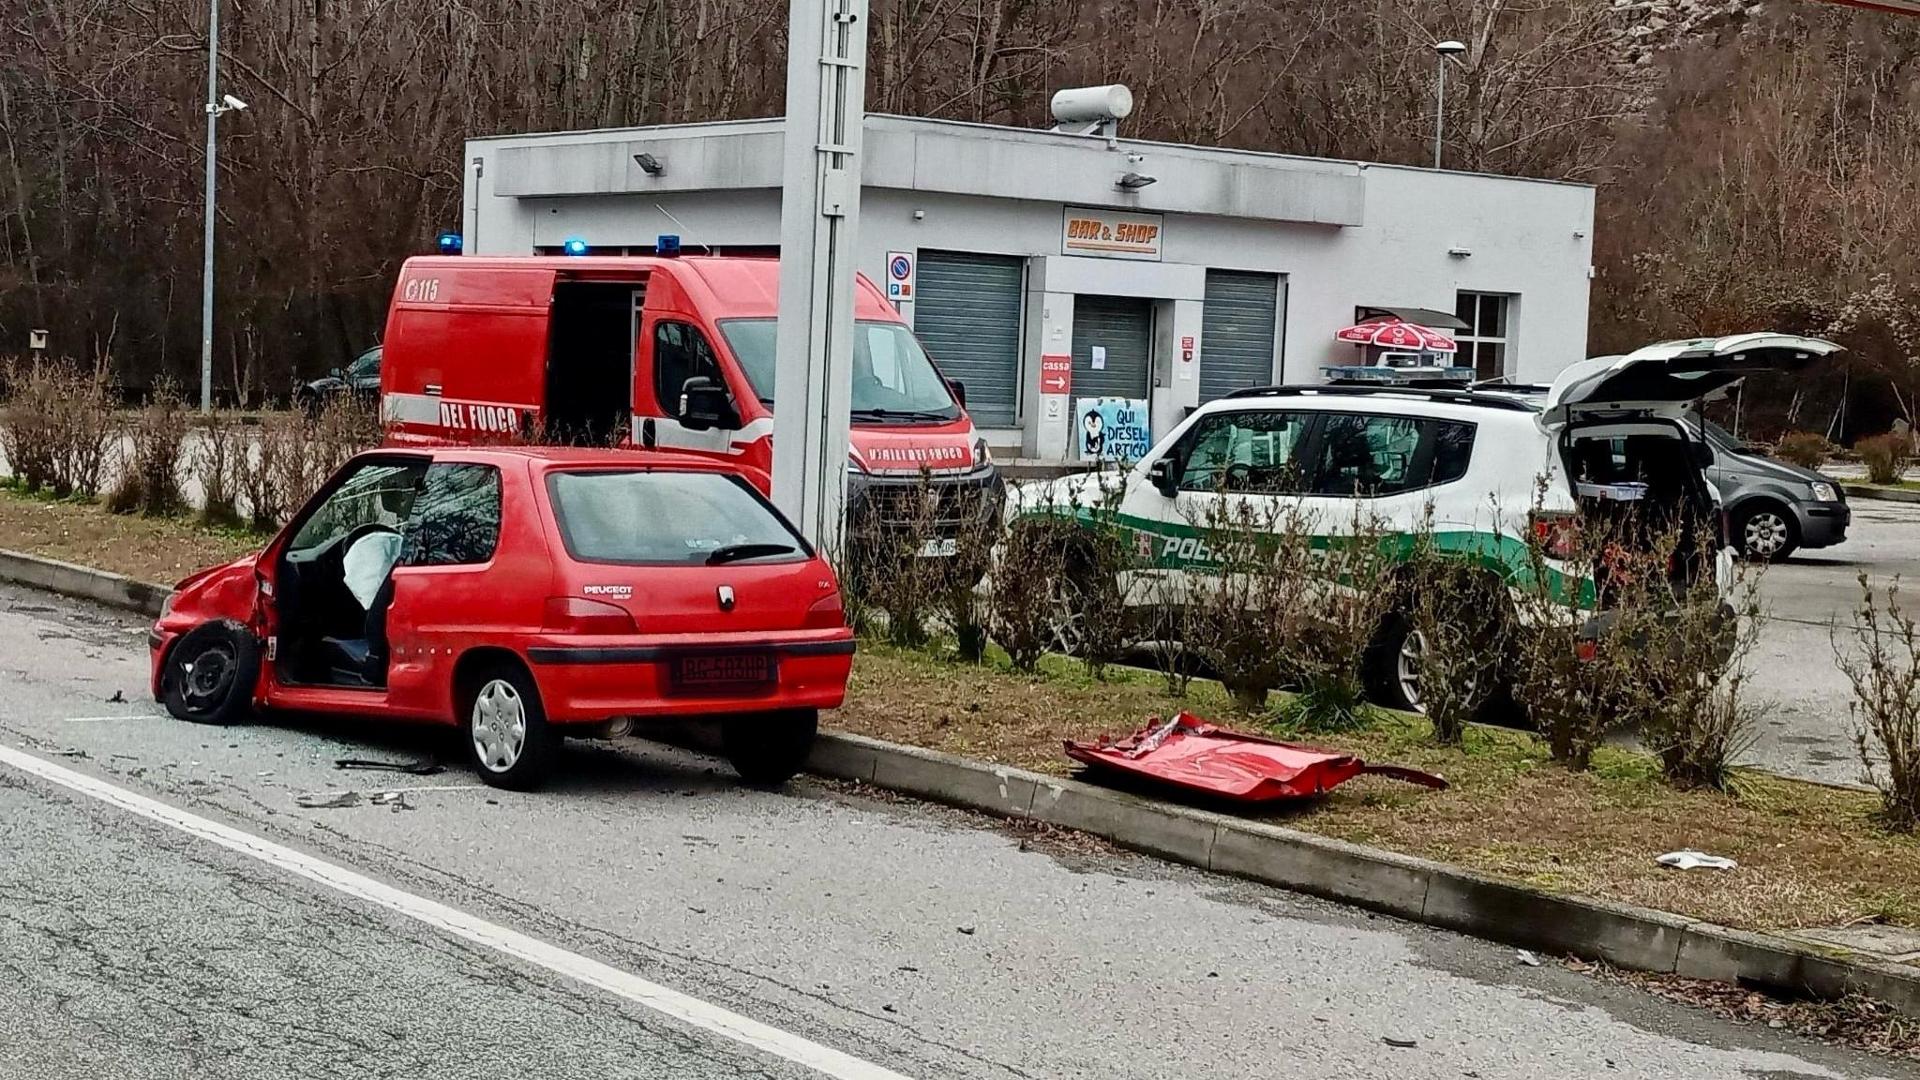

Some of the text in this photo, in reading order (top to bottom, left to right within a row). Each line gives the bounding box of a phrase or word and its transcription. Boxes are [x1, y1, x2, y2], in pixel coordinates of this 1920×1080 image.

[1067, 220, 1158, 243] BAR & SHOP
[419, 279, 439, 301] 115
[1043, 361, 1070, 371] cassa
[441, 403, 518, 433] DEL FUOCO
[1116, 409, 1135, 426] QUI
[1106, 426, 1148, 441] DIESEL
[1106, 442, 1148, 458] ARTICO
[583, 585, 633, 595] PEUGEOT
